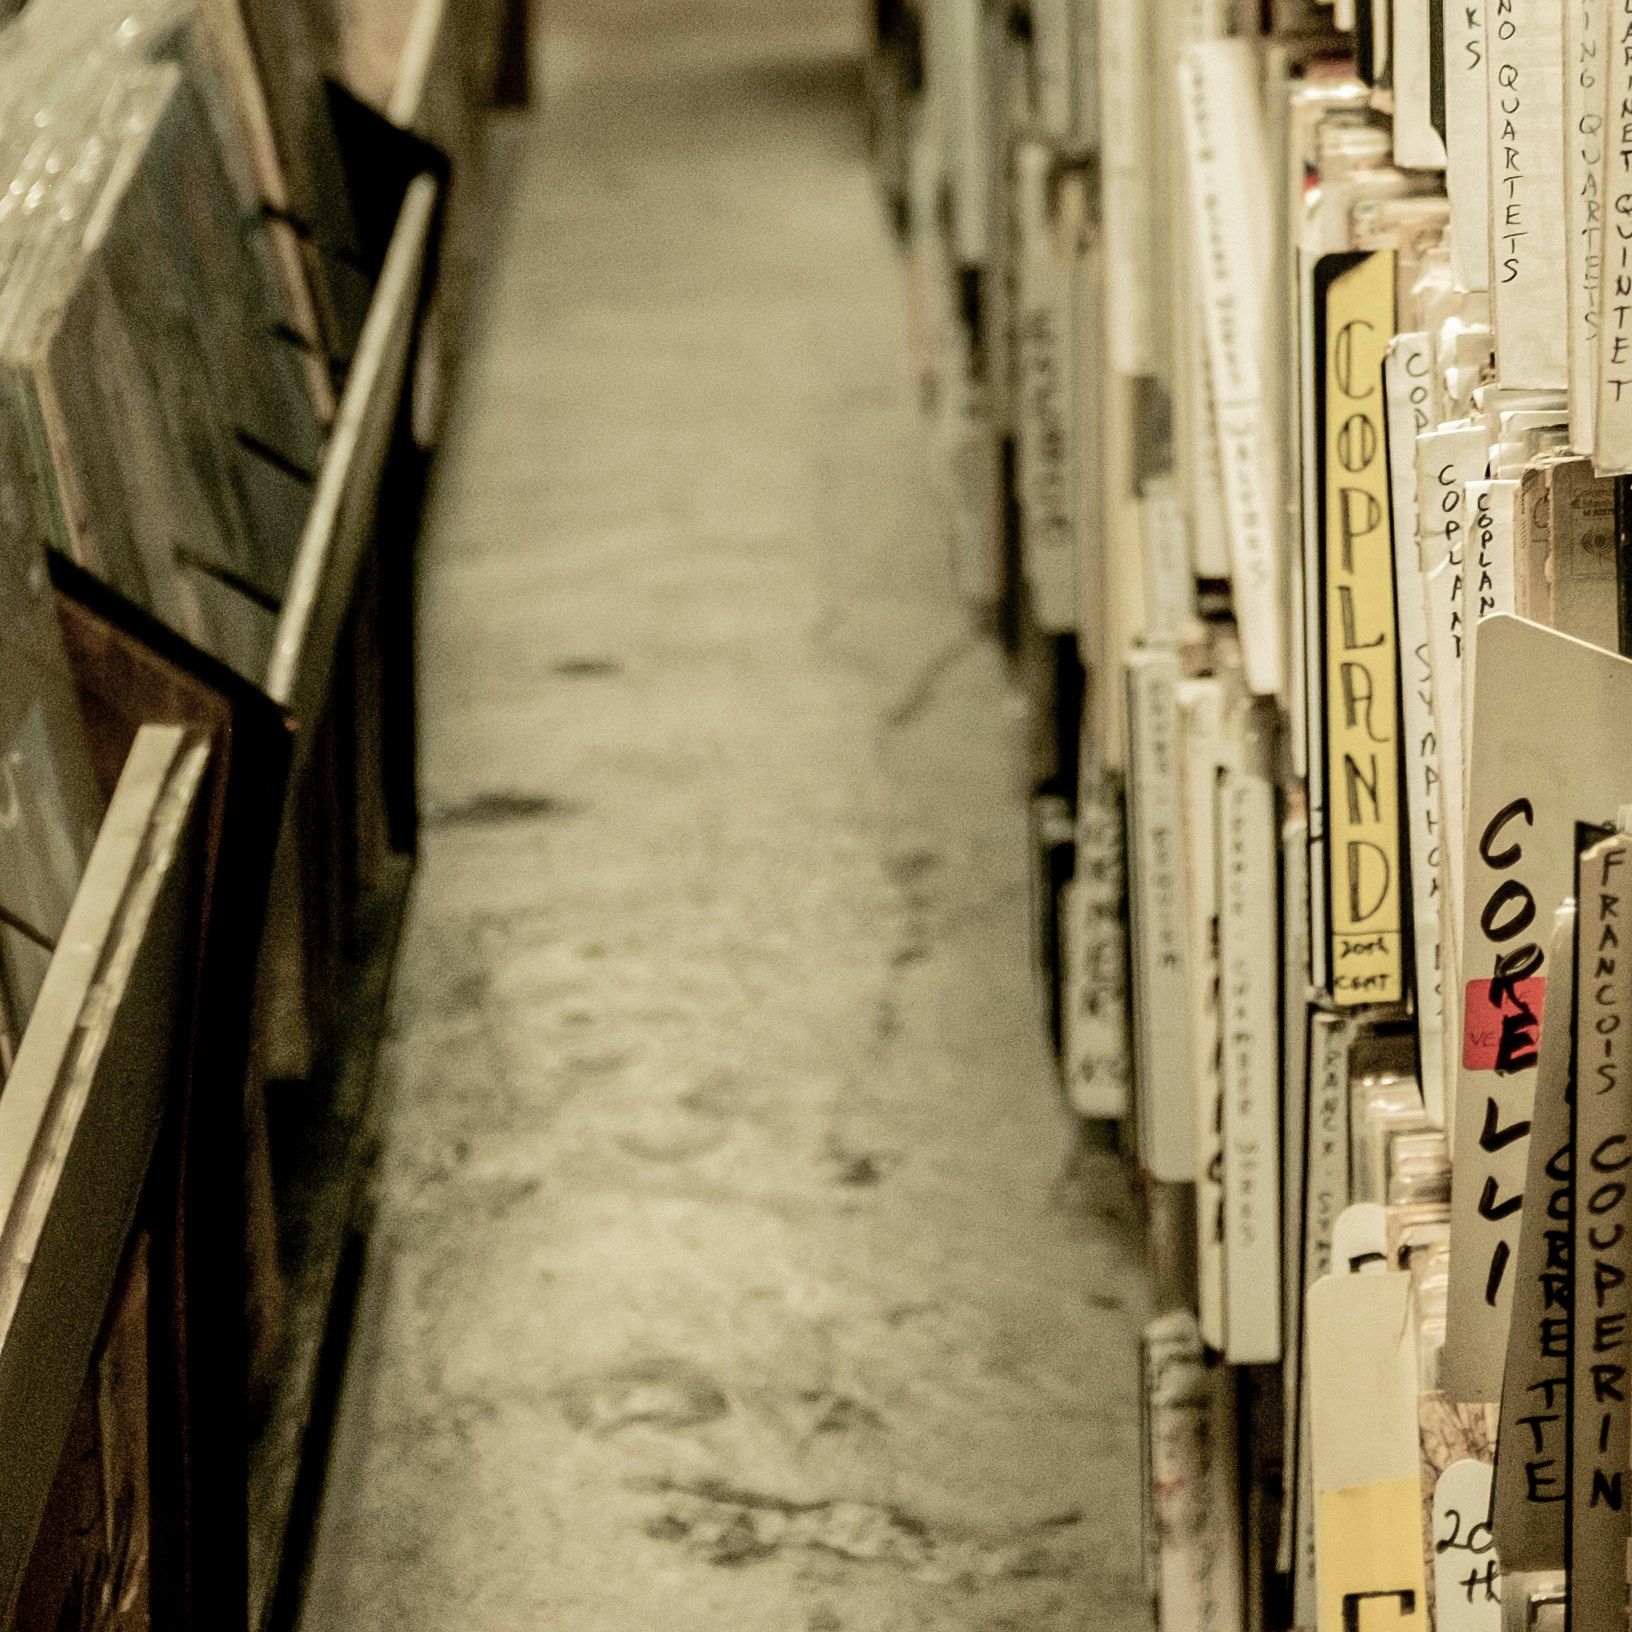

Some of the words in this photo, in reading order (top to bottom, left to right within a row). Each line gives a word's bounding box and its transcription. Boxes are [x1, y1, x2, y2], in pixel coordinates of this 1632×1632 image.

[1494, 64, 1524, 285] QUARTETS
[1576, 112, 1603, 344] QUARTETS
[1334, 318, 1392, 926] COPLAND
[1477, 796, 1546, 1308] CORELLI
[1594, 848, 1626, 1096] FRANCOIS
[1588, 1133, 1632, 1513] COUPERIN
